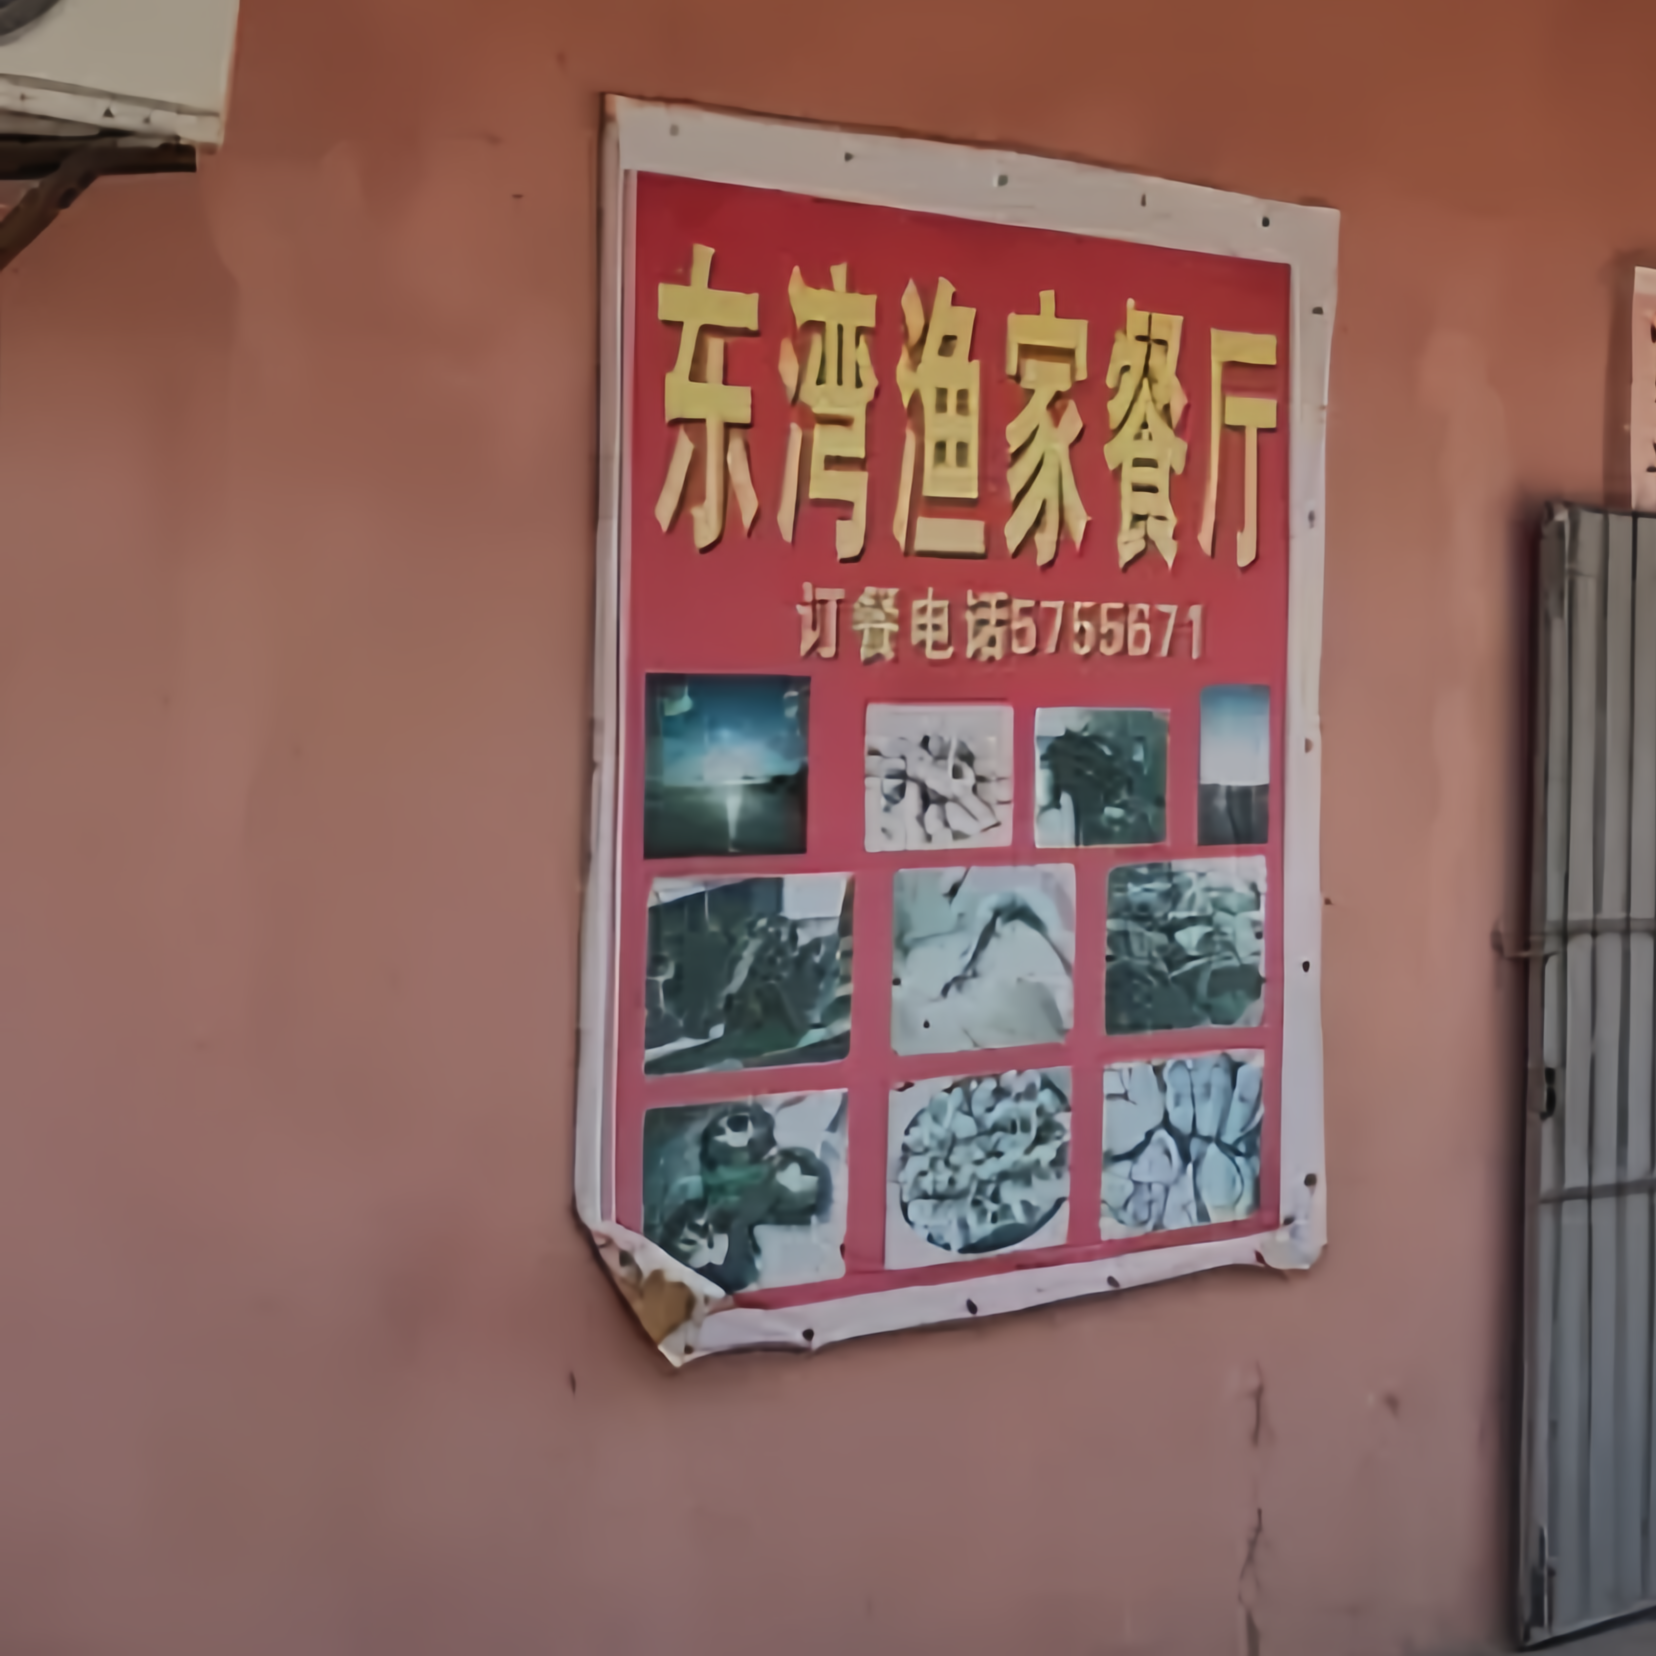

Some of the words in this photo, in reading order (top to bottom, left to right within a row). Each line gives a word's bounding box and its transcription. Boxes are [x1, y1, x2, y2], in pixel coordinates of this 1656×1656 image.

[654, 243, 1278, 570] 东湾渔家餐厅
[795, 581, 1204, 664] 订餐电话5755671
